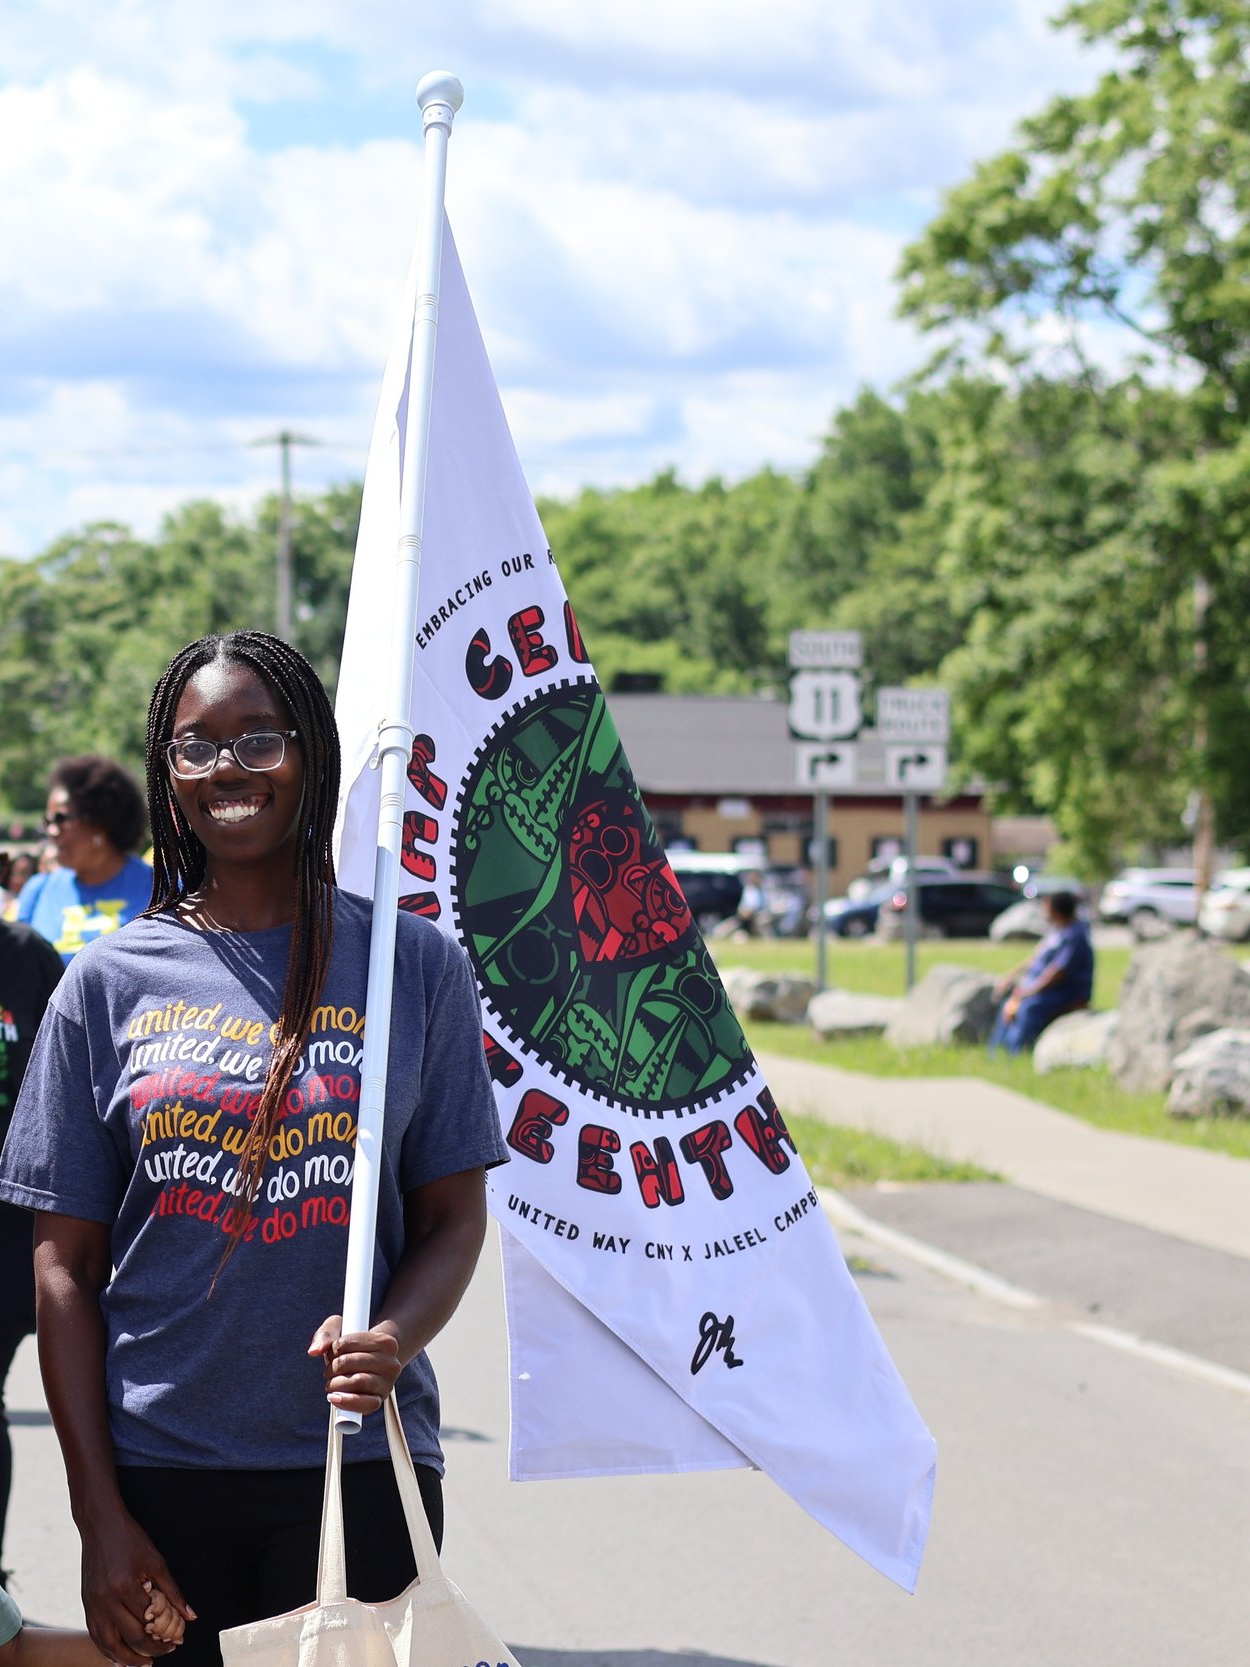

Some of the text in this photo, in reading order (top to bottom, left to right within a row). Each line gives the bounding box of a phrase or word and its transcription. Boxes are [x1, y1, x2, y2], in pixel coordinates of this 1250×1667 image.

[415, 553, 535, 650] EMBRACING OUR
[814, 686, 841, 725] 11
[221, 1016, 265, 1046] we
[129, 1031, 222, 1075] united,
[219, 1049, 263, 1082] we
[219, 1087, 263, 1121] we
[269, 1124, 304, 1162] do
[267, 1166, 300, 1203] do
[151, 1180, 225, 1223] nited,
[262, 1206, 297, 1244] do
[507, 1193, 580, 1241] UNITED
[592, 1231, 631, 1255] WAY
[644, 1242, 674, 1260] CNY
[703, 1228, 767, 1260] JALEEL
[773, 1185, 819, 1232] CAMPB
